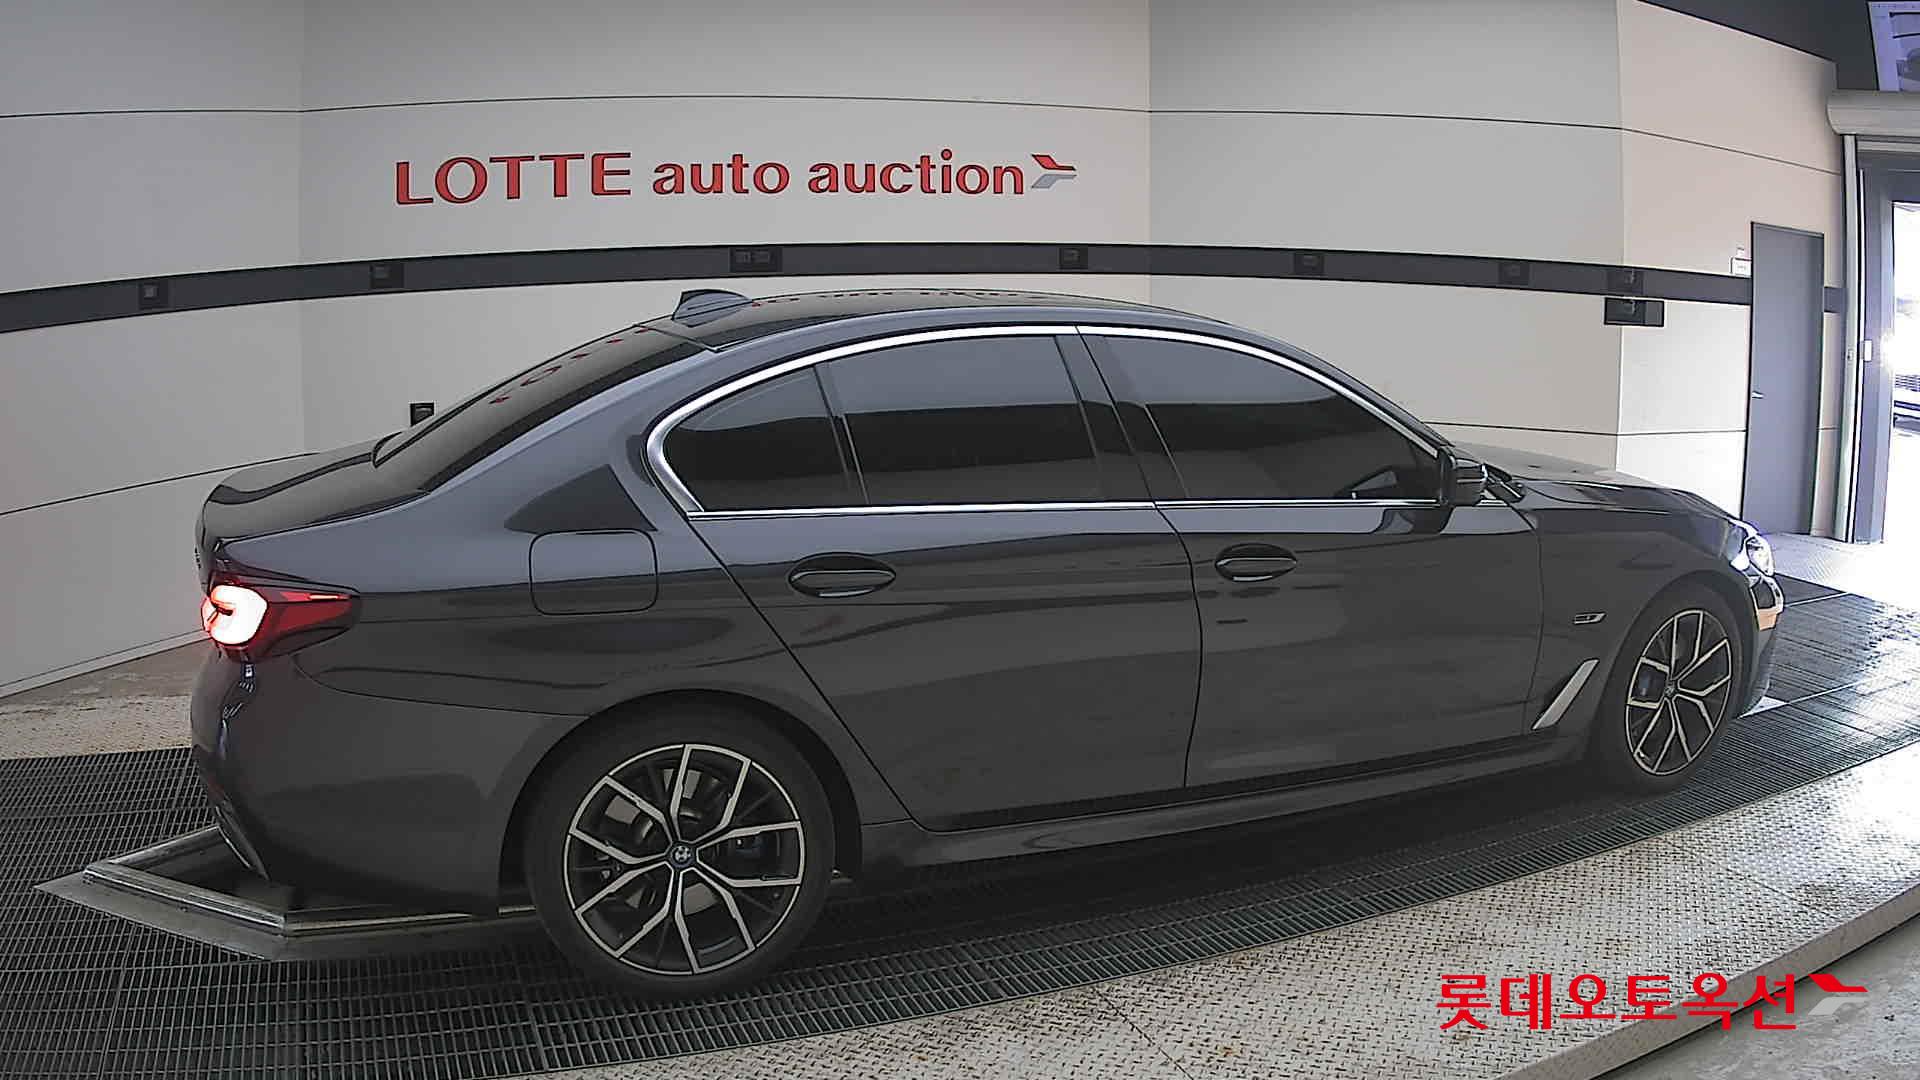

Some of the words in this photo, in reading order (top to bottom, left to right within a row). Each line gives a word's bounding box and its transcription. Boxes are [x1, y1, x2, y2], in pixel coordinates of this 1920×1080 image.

[395, 152, 632, 205] LOTTE
[653, 153, 791, 195] auto
[808, 149, 1025, 195] auction
